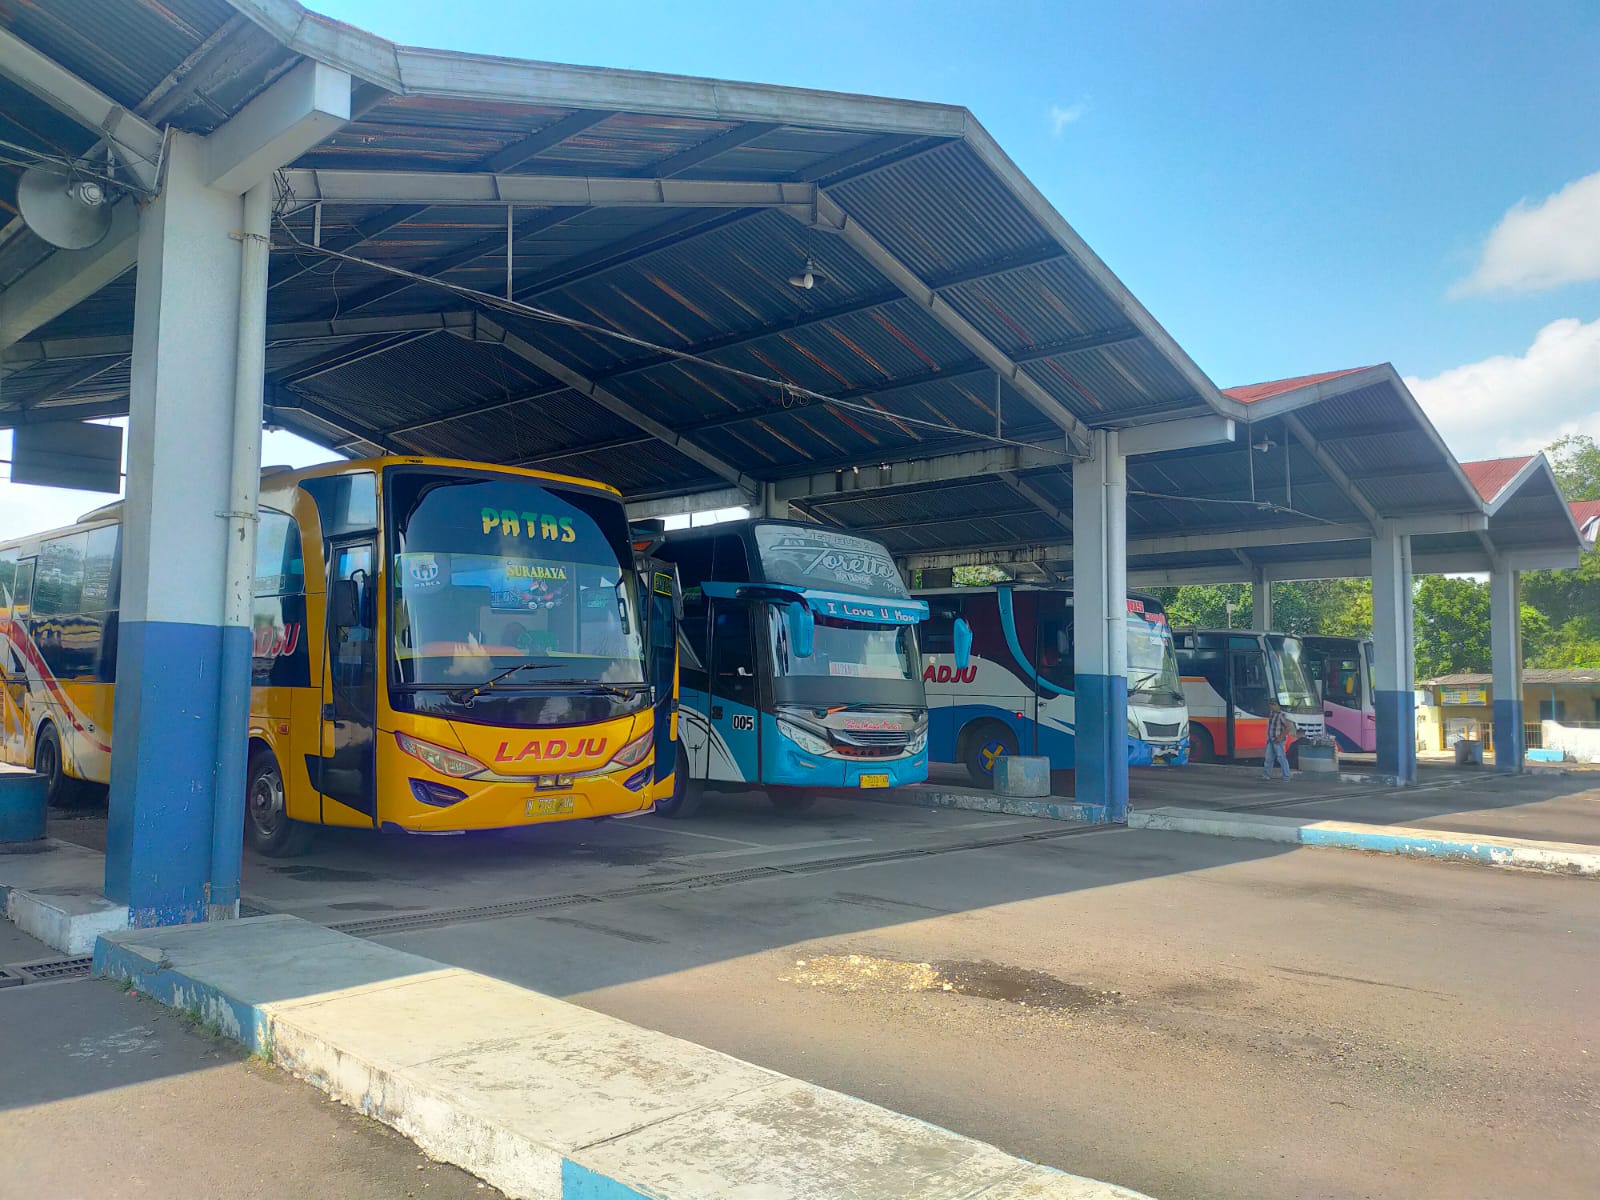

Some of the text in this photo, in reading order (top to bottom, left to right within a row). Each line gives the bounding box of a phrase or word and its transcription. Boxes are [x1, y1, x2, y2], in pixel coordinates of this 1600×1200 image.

[481, 507, 576, 543] PATAS
[507, 565, 567, 580] SURABAYA
[770, 546, 894, 578] Toretto
[827, 602, 837, 614] I
[843, 604, 874, 617] Love
[880, 607, 889, 619] U
[252, 622, 301, 657] DJU
[733, 715, 754, 730] 005
[495, 738, 607, 762] LADJU
